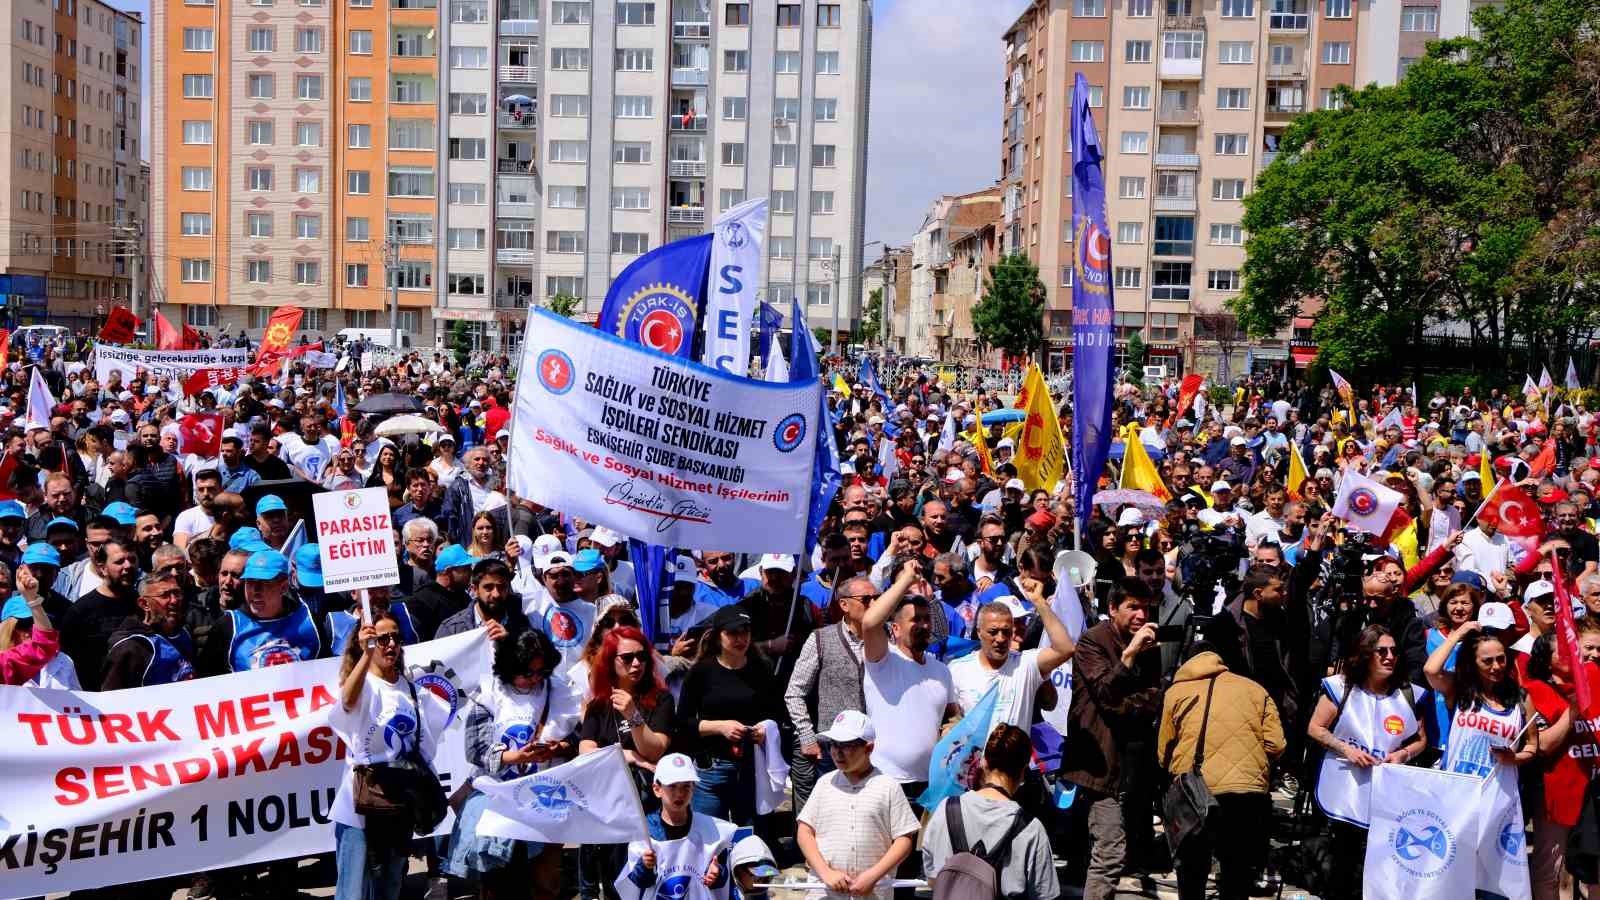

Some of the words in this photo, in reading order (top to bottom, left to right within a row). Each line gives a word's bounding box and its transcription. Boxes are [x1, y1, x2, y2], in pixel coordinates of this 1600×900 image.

[585, 372, 636, 406] SAĞLIK
[638, 392, 655, 410] ve
[658, 395, 710, 429] SOSYAL
[714, 411, 767, 439] HİZMET
[651, 366, 712, 402] TÜRKİYE
[587, 427, 644, 460] ESKİŞEHİR
[645, 446, 676, 469] ŞUBE
[677, 455, 744, 483] BAŞKANLIĞI
[601, 401, 660, 440] İŞÇİLERİ
[662, 423, 739, 460] SENDİKASI
[536, 429, 578, 456] Sağlık
[582, 450, 600, 465] ve
[604, 456, 653, 480] Sosyal
[657, 473, 712, 495] Hizmet
[320, 514, 388, 536] PARASIZ
[329, 537, 386, 560] EĞİTİM
[18, 707, 182, 746] TÜRK
[54, 726, 347, 806] SENDİKASI
[191, 804, 208, 842] 1
[228, 787, 336, 837] NOLU
